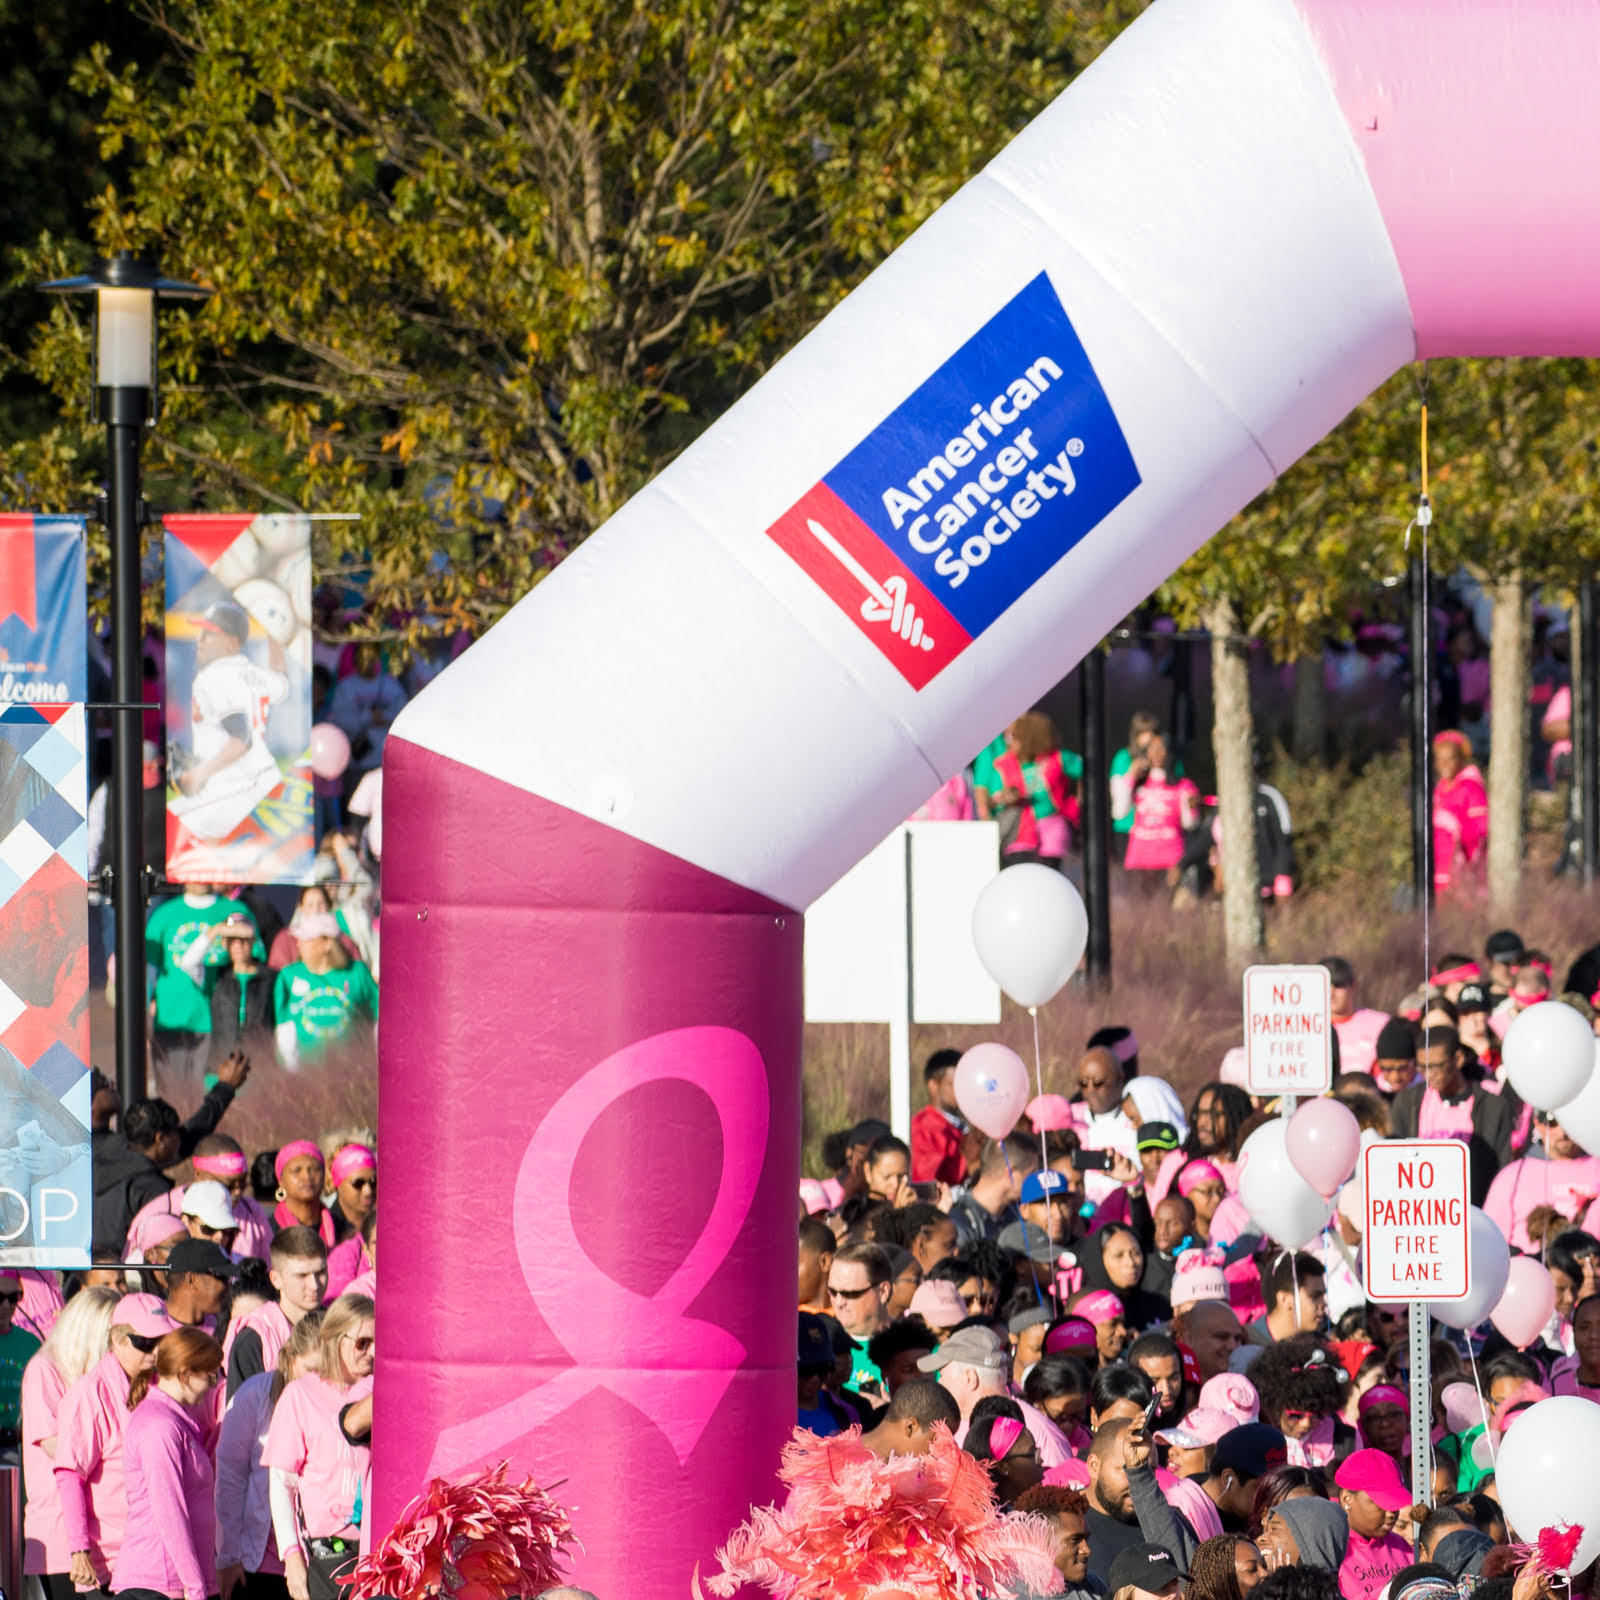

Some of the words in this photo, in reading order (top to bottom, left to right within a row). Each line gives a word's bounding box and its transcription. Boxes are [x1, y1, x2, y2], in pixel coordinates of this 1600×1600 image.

[881, 356, 1064, 530] American
[908, 427, 1039, 554] Cancer
[0, 672, 69, 702] lcome
[1272, 983, 1301, 1006] NO
[1252, 1014, 1322, 1034] PARKING
[1270, 1041, 1305, 1057] FIRE
[1268, 1063, 1308, 1078] LANE
[1398, 1162, 1434, 1189] NO
[1372, 1199, 1461, 1227] PARKING
[1395, 1236, 1439, 1254] FIRE
[1392, 1263, 1442, 1281] LANE
